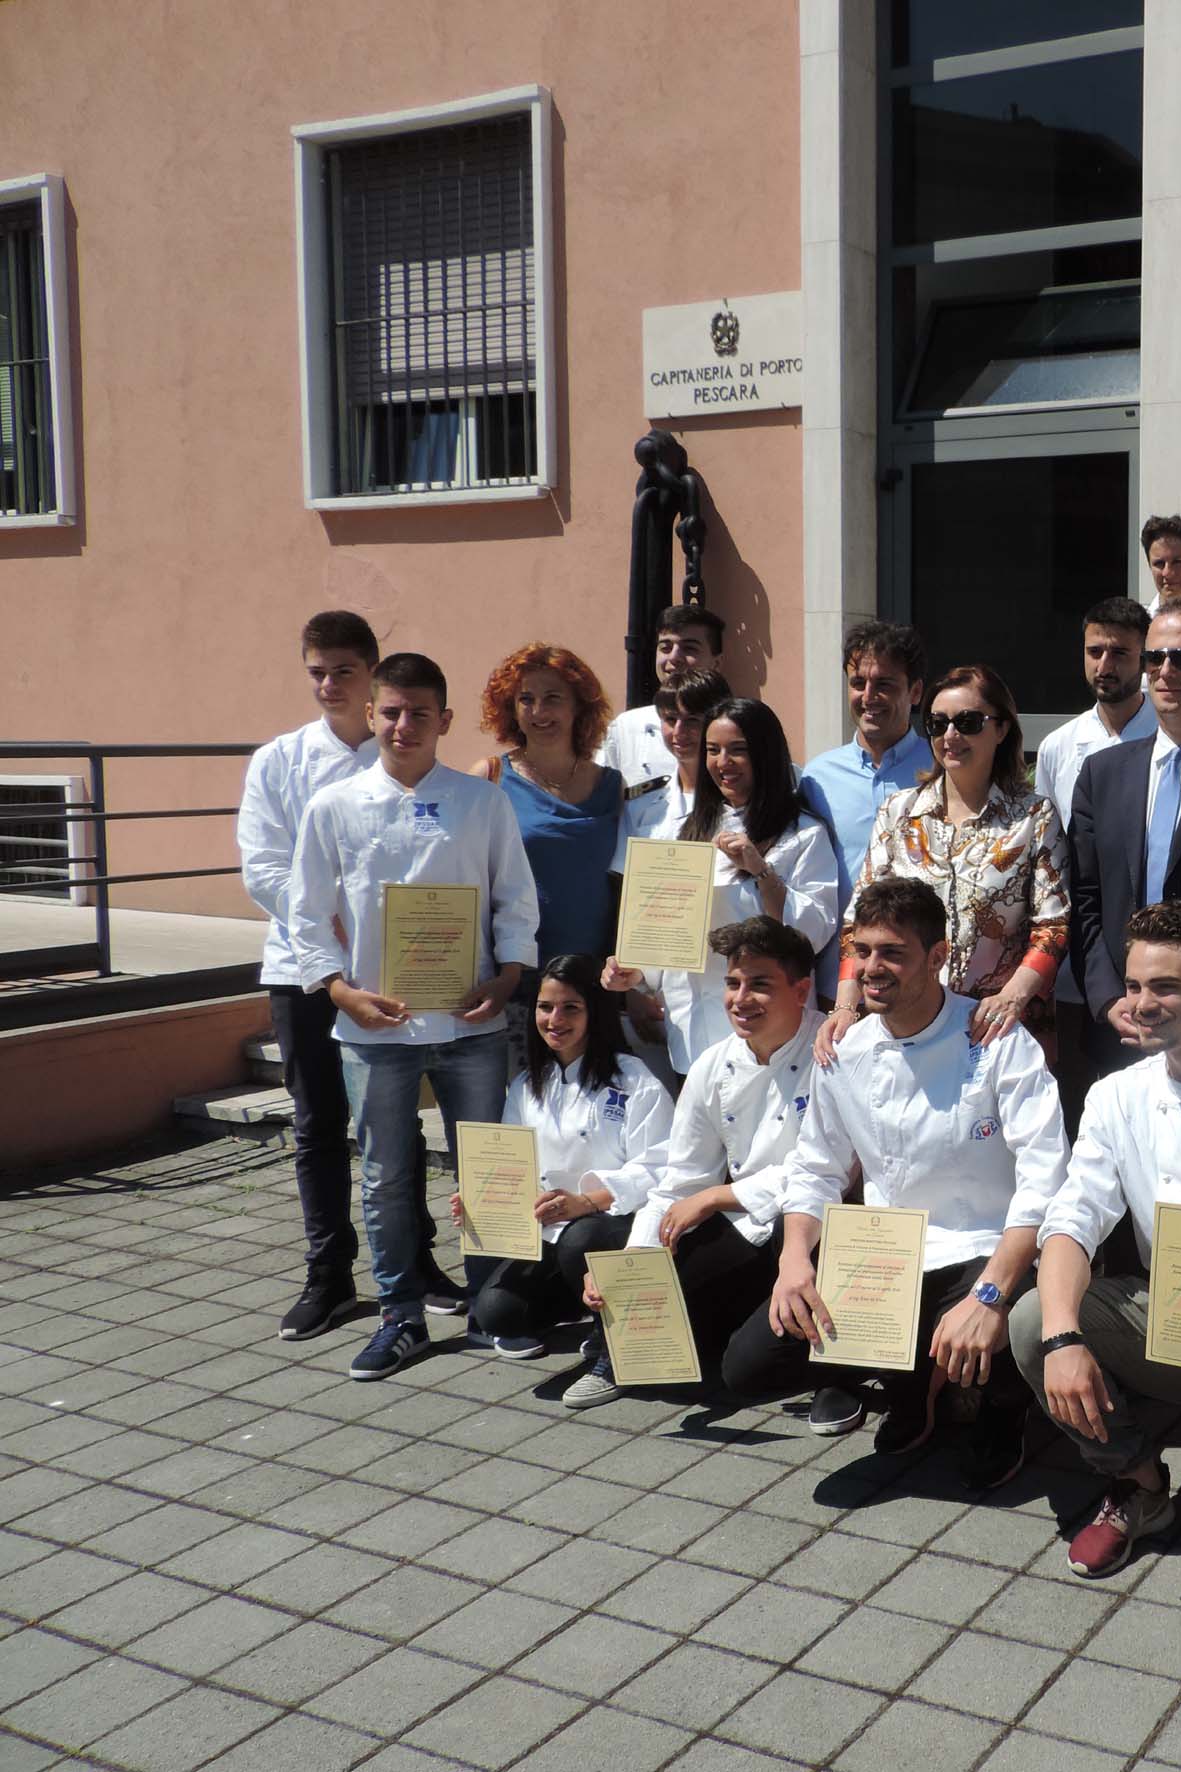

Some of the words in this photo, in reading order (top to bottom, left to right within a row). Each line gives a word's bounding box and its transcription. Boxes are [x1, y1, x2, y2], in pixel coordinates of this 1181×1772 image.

[650, 364, 733, 386] CAPITANERIA
[740, 362, 753, 377] DI
[760, 358, 803, 376] PORTO
[694, 383, 760, 405] PESCARA
